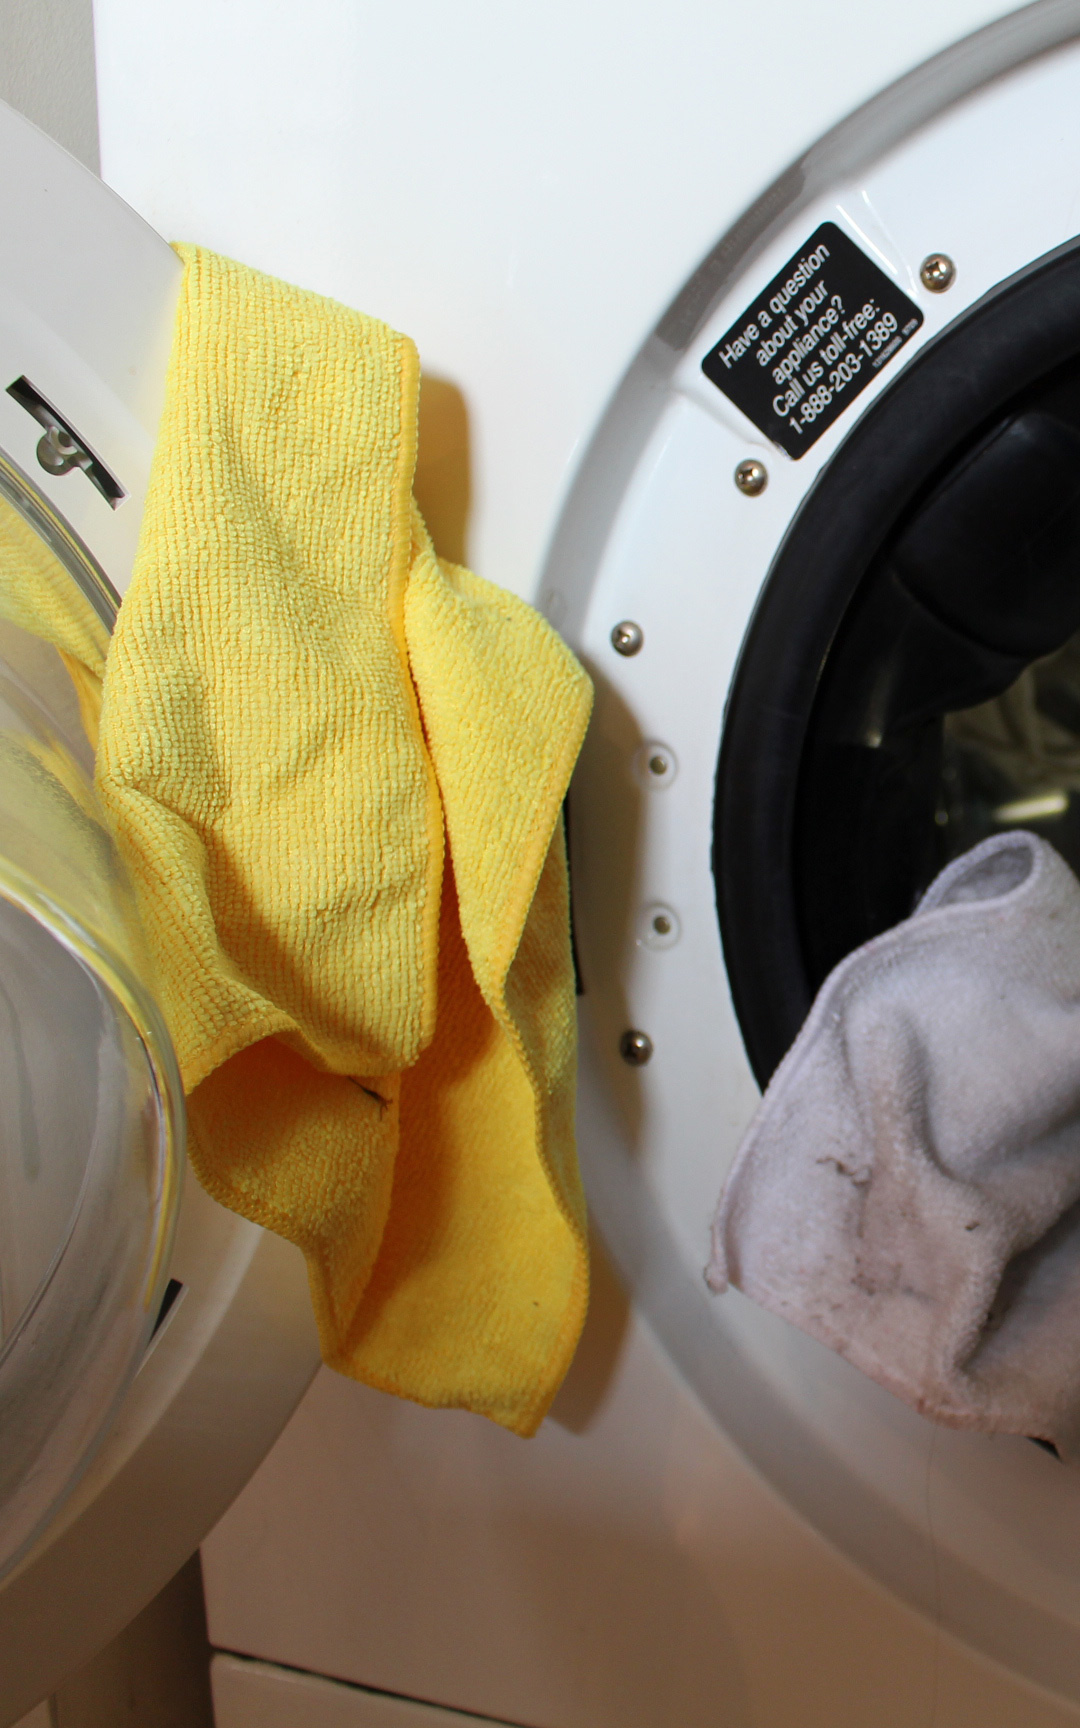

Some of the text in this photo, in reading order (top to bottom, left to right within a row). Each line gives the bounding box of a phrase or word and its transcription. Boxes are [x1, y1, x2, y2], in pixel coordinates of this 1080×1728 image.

[718, 244, 831, 369] Have a question
[756, 280, 829, 367] about your
[772, 294, 846, 385] appliance?
[772, 298, 880, 417] Call us toll-free:
[788, 312, 899, 434] 1-888-203-1389
